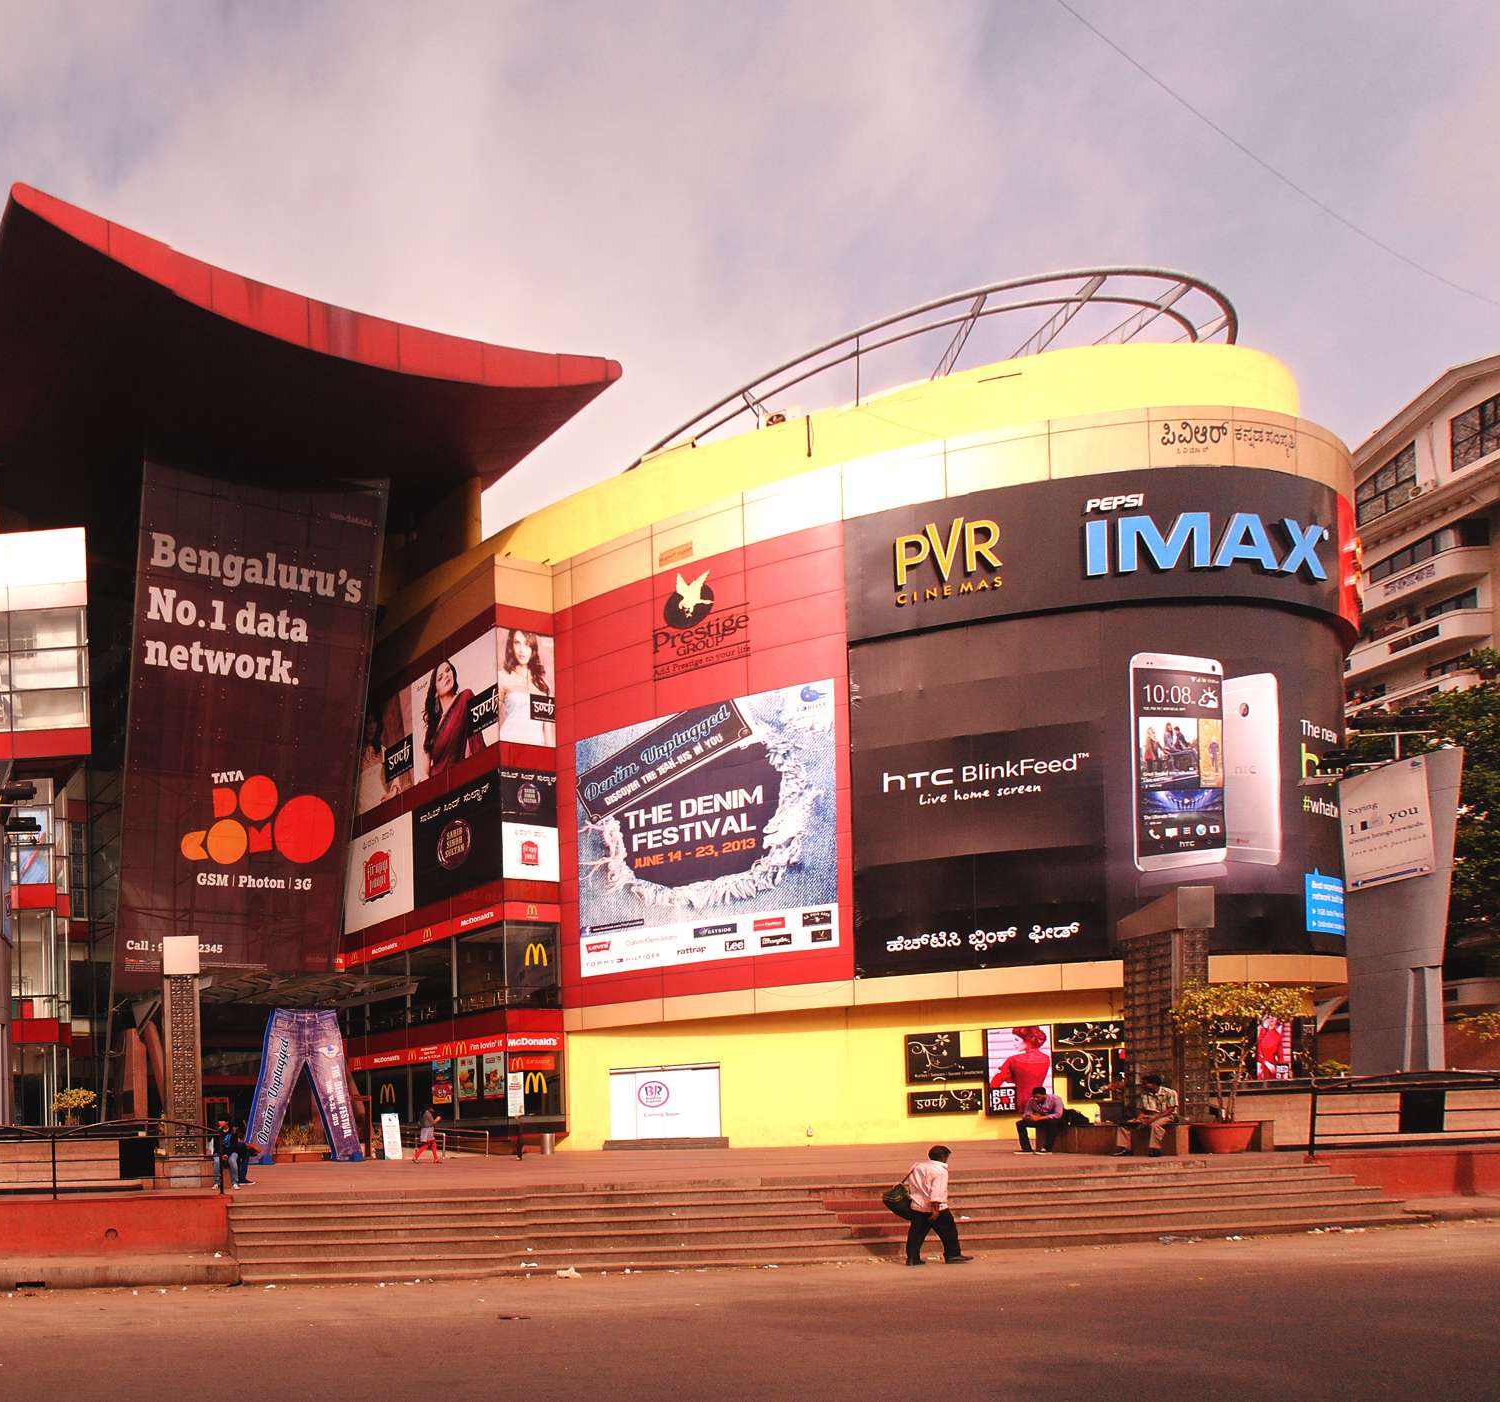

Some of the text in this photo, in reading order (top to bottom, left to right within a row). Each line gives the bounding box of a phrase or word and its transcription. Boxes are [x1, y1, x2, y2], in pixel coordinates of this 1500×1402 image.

[1084, 493, 1144, 513] PEPSI
[895, 516, 1003, 587] PVR
[1084, 511, 1329, 580] IMAX
[896, 576, 1003, 605] CINEMAS
[235, 601, 308, 643] data
[652, 613, 750, 655] Prestige
[676, 636, 723, 657] GROUP
[144, 639, 300, 686] network.
[1143, 684, 1191, 704] 10:08
[641, 703, 731, 767] Unplugged
[1300, 719, 1320, 739] The
[211, 770, 245, 784] TATA
[624, 785, 764, 830] THE DENIM
[919, 783, 1042, 806] Live home screen
[1388, 806, 1419, 824] you
[631, 813, 757, 853] FESTIVAL
[634, 855, 664, 869] JUNE
[722, 837, 756, 853] 2013
[196, 872, 313, 891] GSM Photon 3G
[126, 940, 149, 951] Call
[992, 1088, 1016, 1097] RED
